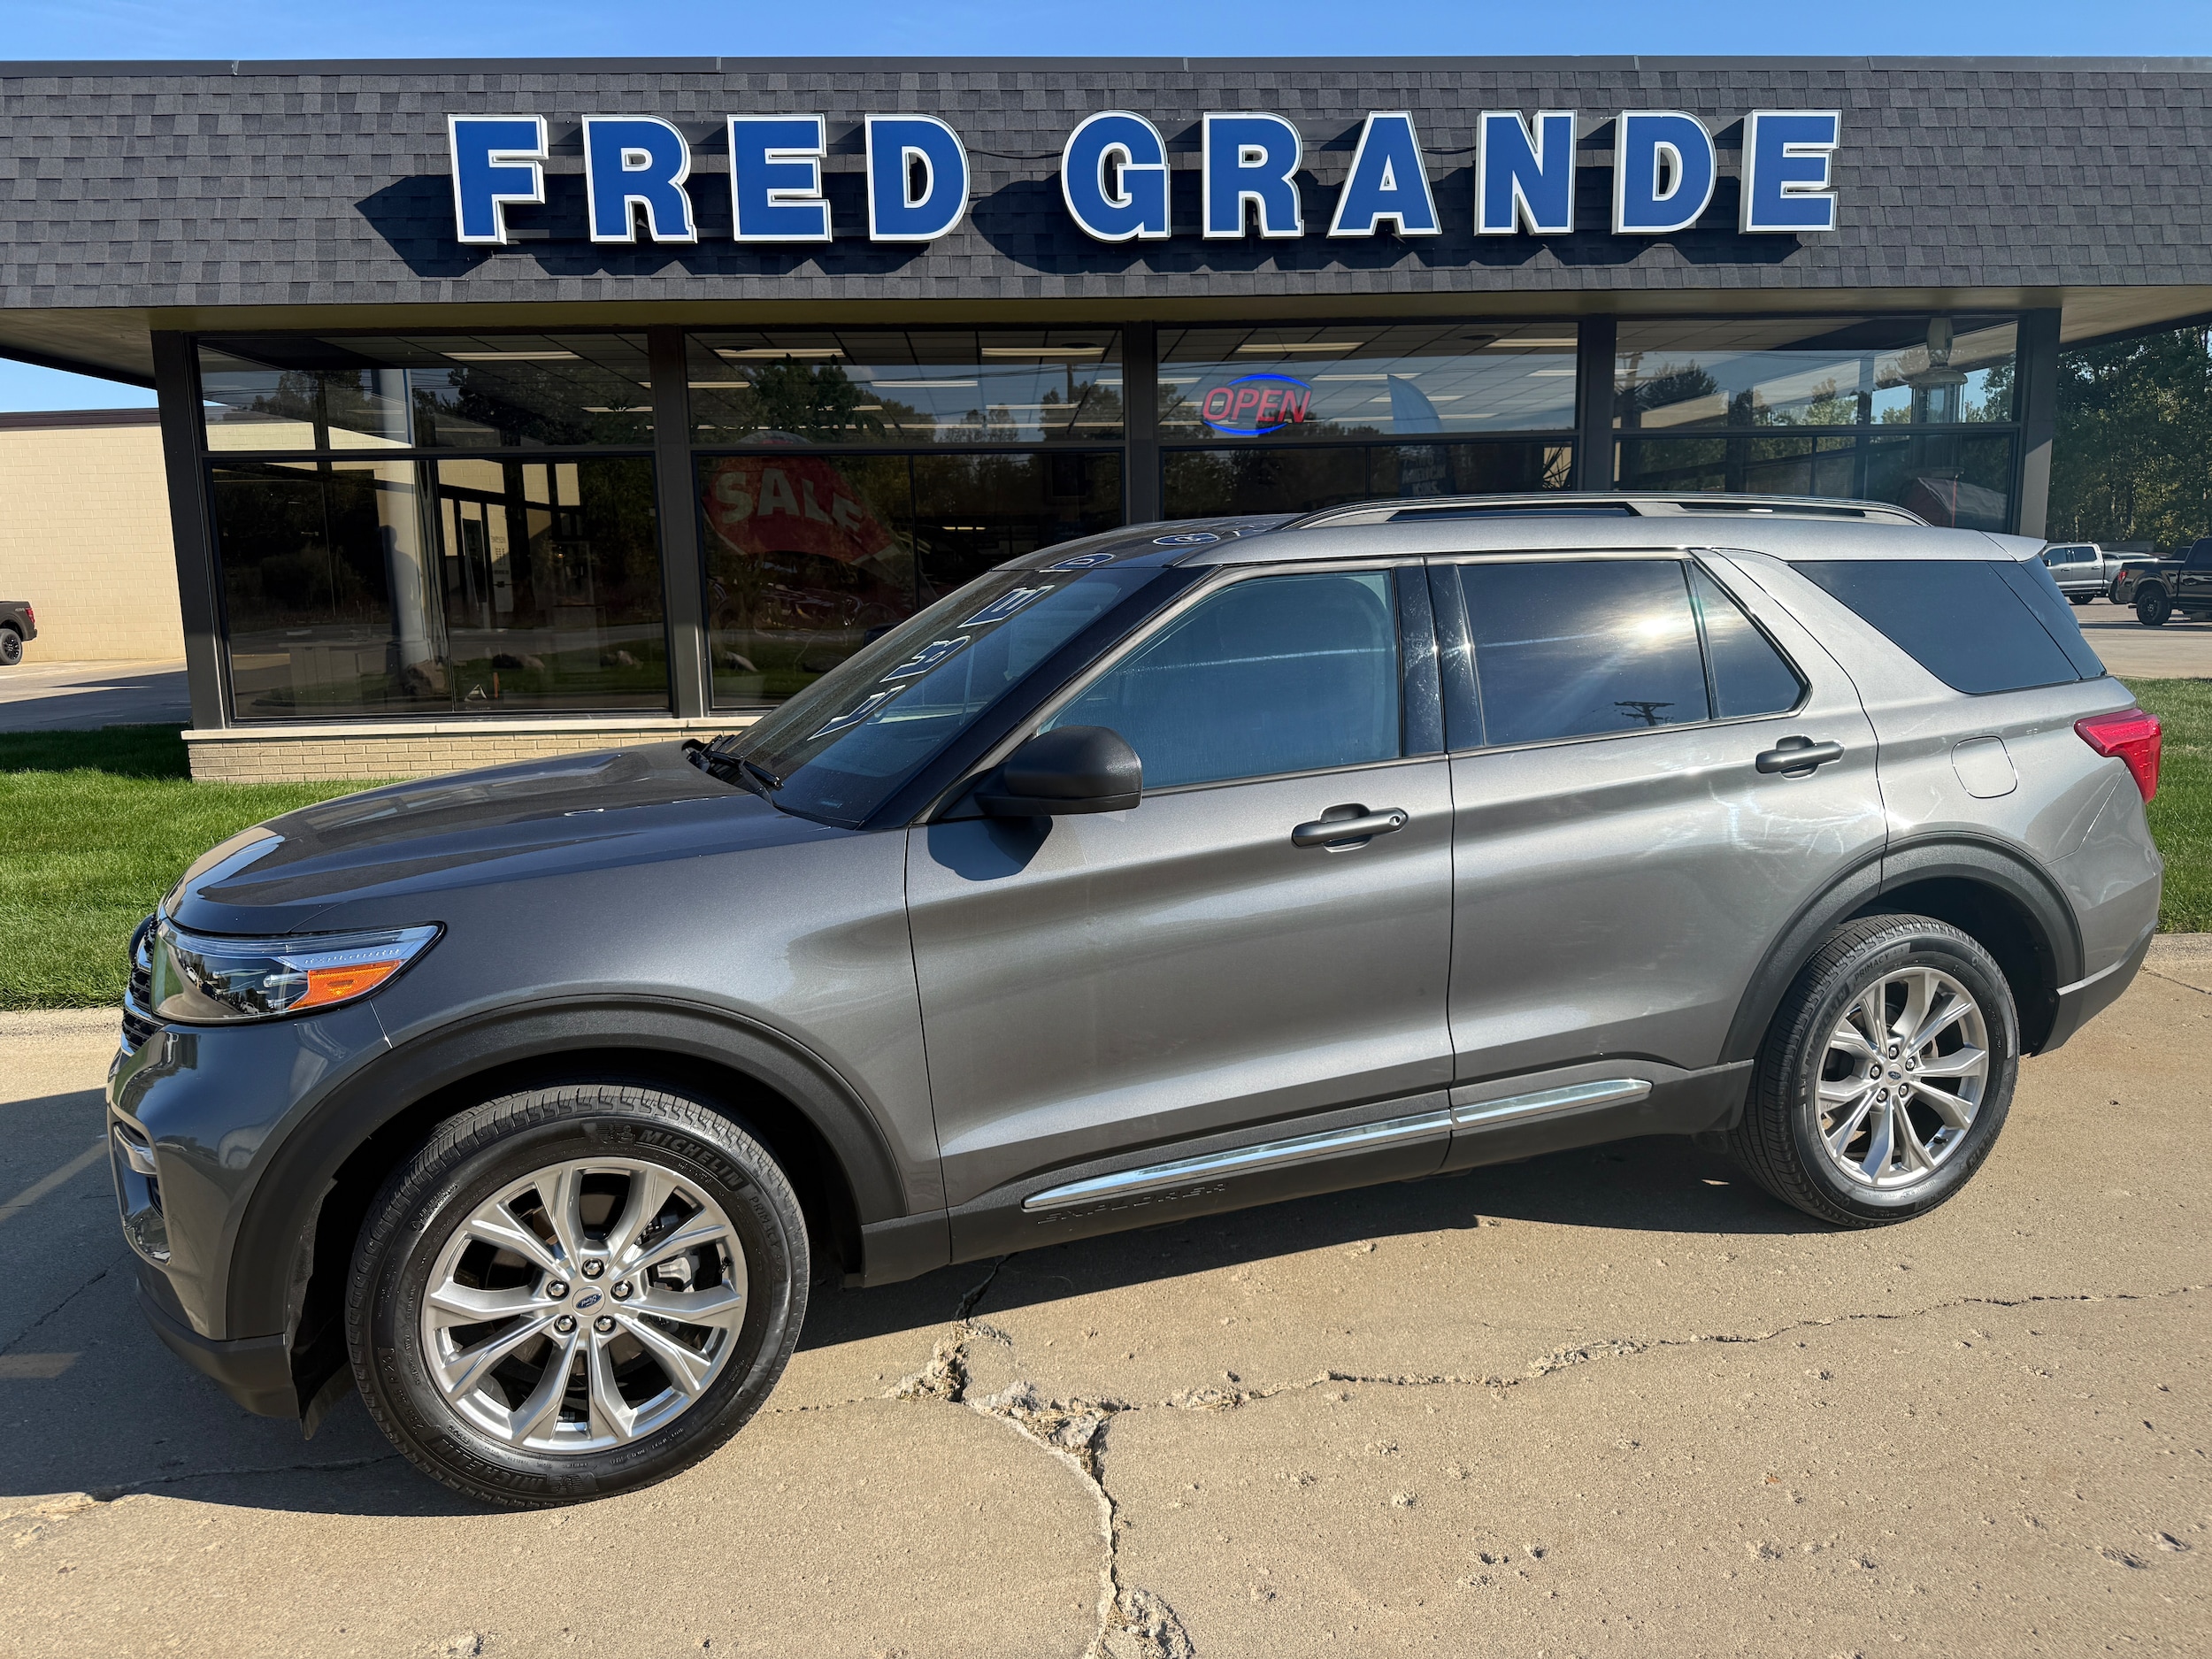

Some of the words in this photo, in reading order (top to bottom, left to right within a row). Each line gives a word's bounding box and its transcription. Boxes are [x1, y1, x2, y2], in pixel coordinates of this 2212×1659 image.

[448, 113, 971, 245] FRED
[1060, 108, 1842, 242] GRANDE
[1202, 387, 1311, 423] OPEN
[716, 467, 863, 543] SALE
[639, 1129, 745, 1187] MICHELIN
[749, 1195, 782, 1249] PRIMACY
[1037, 1182, 1229, 1225] EXPLORER
[430, 1438, 545, 1493] MICHELIN
